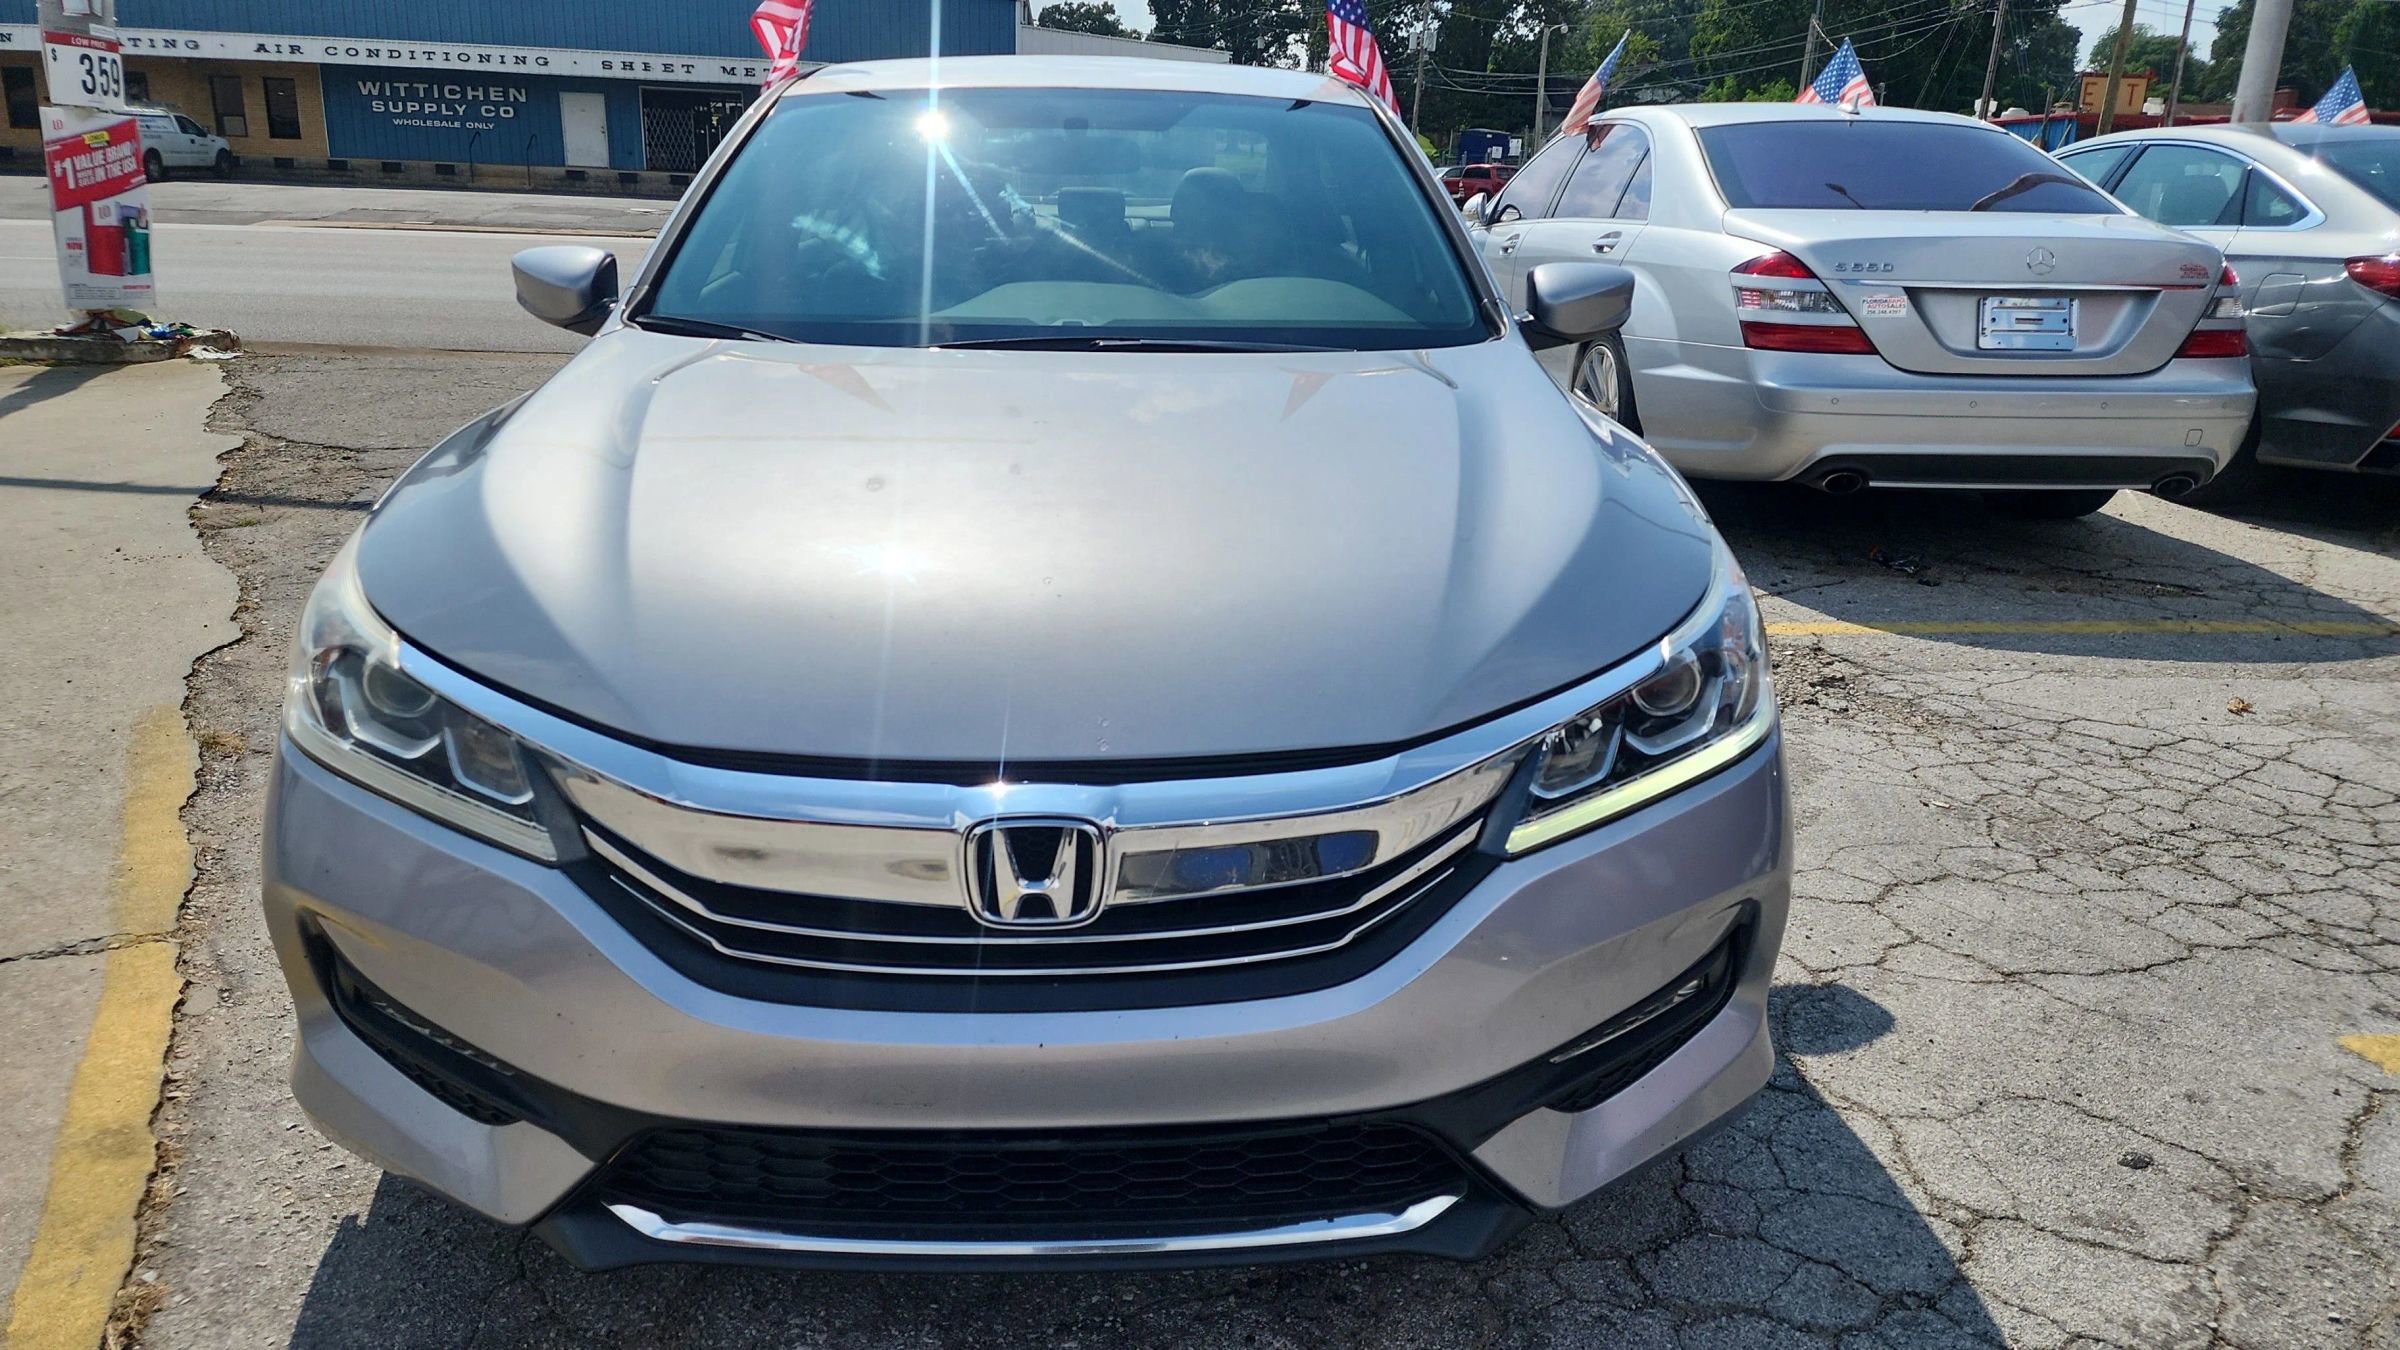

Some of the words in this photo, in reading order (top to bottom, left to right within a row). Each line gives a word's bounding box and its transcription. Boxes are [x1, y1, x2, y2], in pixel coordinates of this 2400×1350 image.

[71, 37, 89, 46] LOW
[51, 47, 57, 62] $
[253, 43, 304, 55] AIR
[324, 46, 550, 66] CONDITIONING
[601, 60, 695, 74] SHEET
[357, 80, 527, 103] WITTICHEN
[371, 101, 467, 117] SUPPLY
[480, 105, 515, 119] CO
[392, 118, 461, 130] WHOLESALE
[466, 121, 495, 131] ONLY
[73, 149, 106, 171] VALUE
[105, 160, 124, 179] THE
